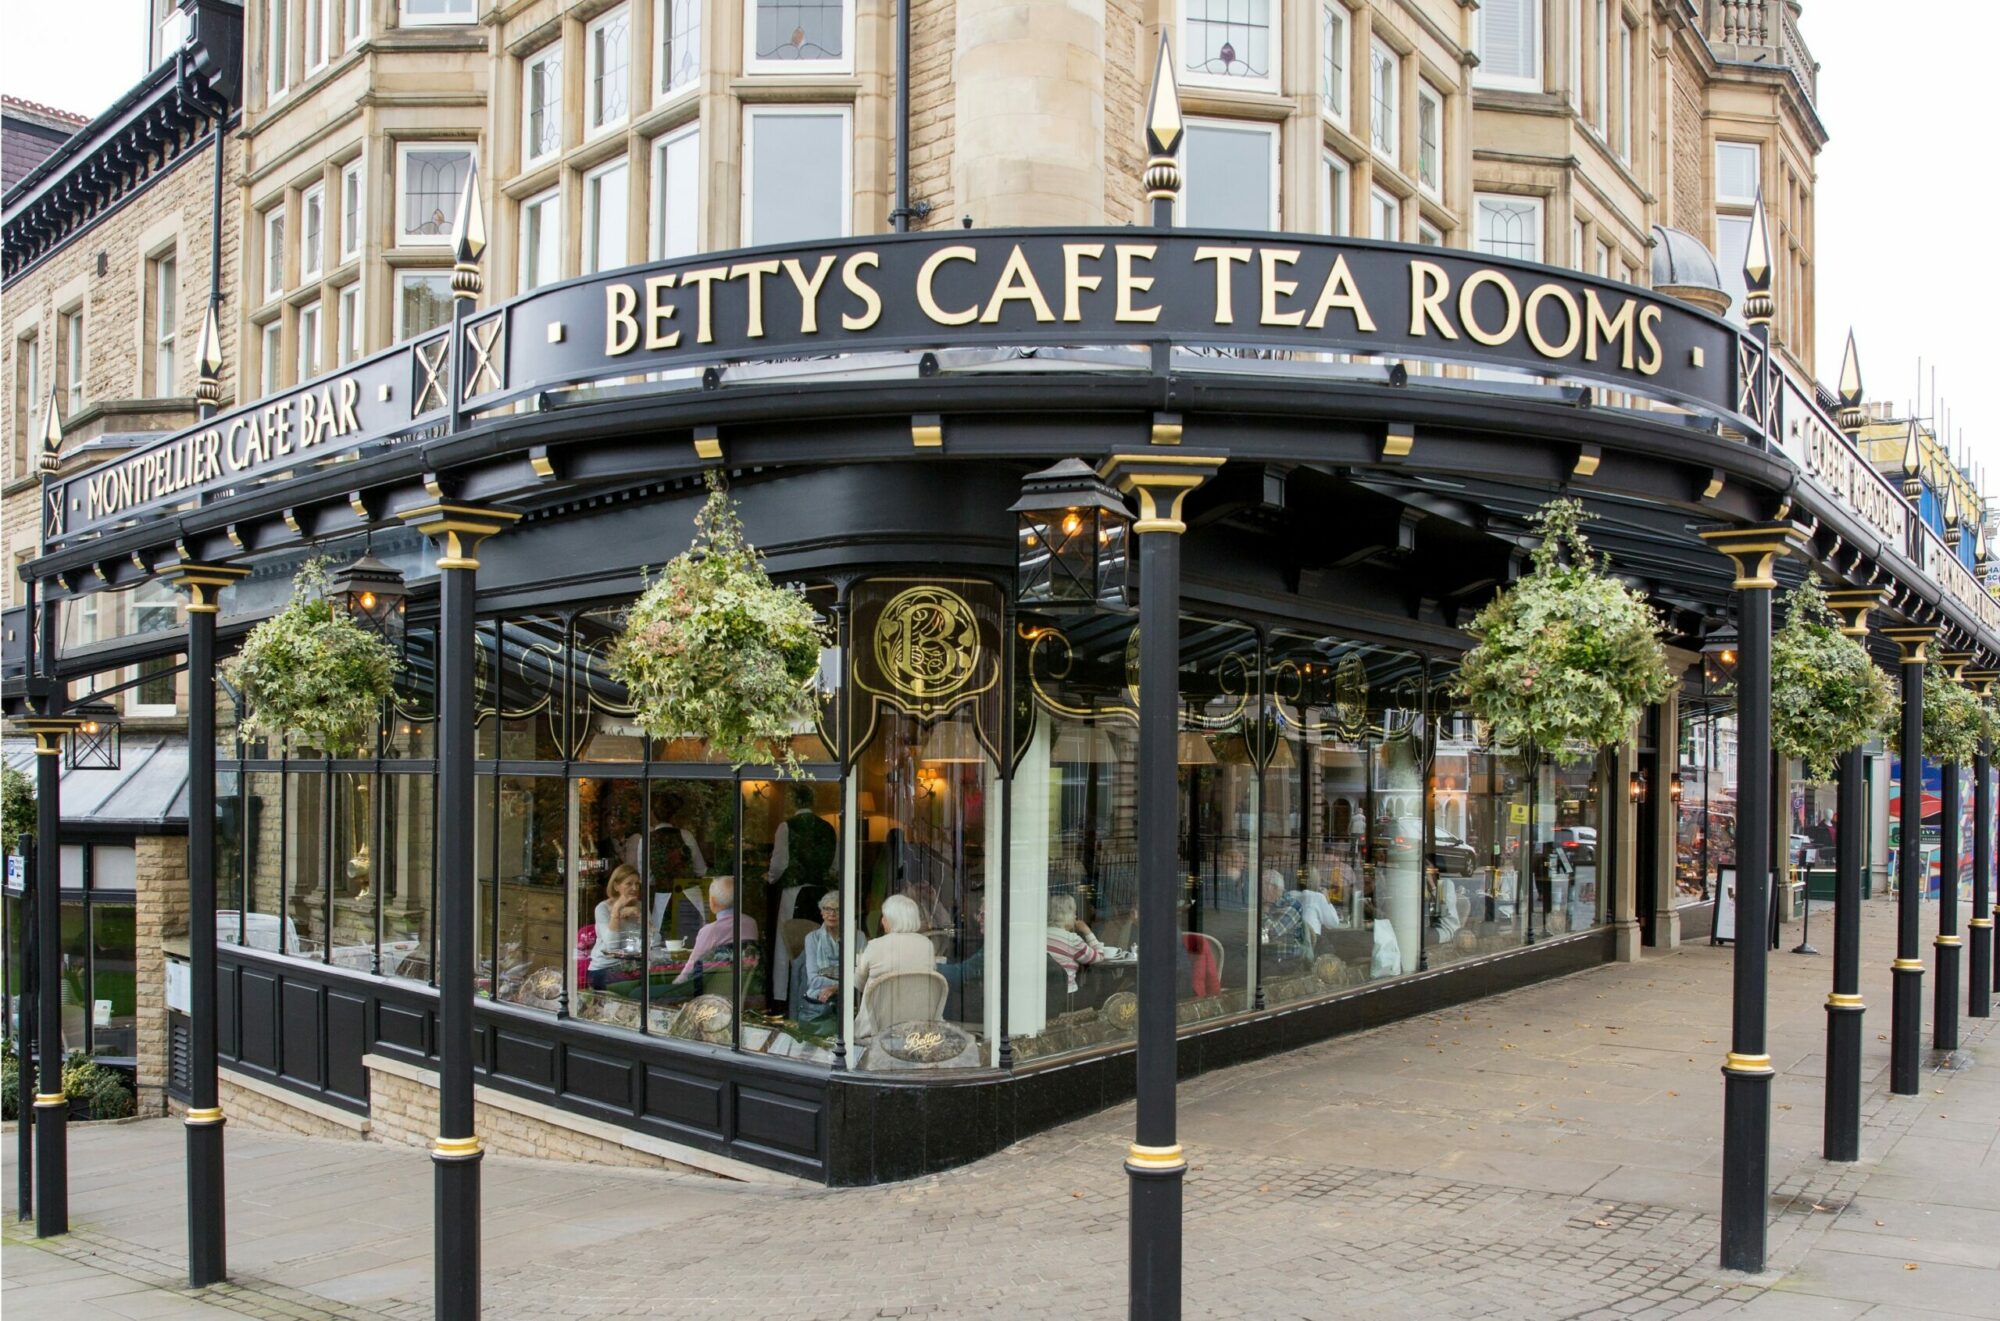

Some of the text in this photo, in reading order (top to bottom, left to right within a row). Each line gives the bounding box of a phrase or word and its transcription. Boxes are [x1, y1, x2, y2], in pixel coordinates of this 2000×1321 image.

[604, 243, 1664, 376] BETTYS CAFE TEA ROOMS
[87, 377, 361, 520] MONTPELLIER CAFE BAR
[903, 1031, 945, 1053] Bettys
